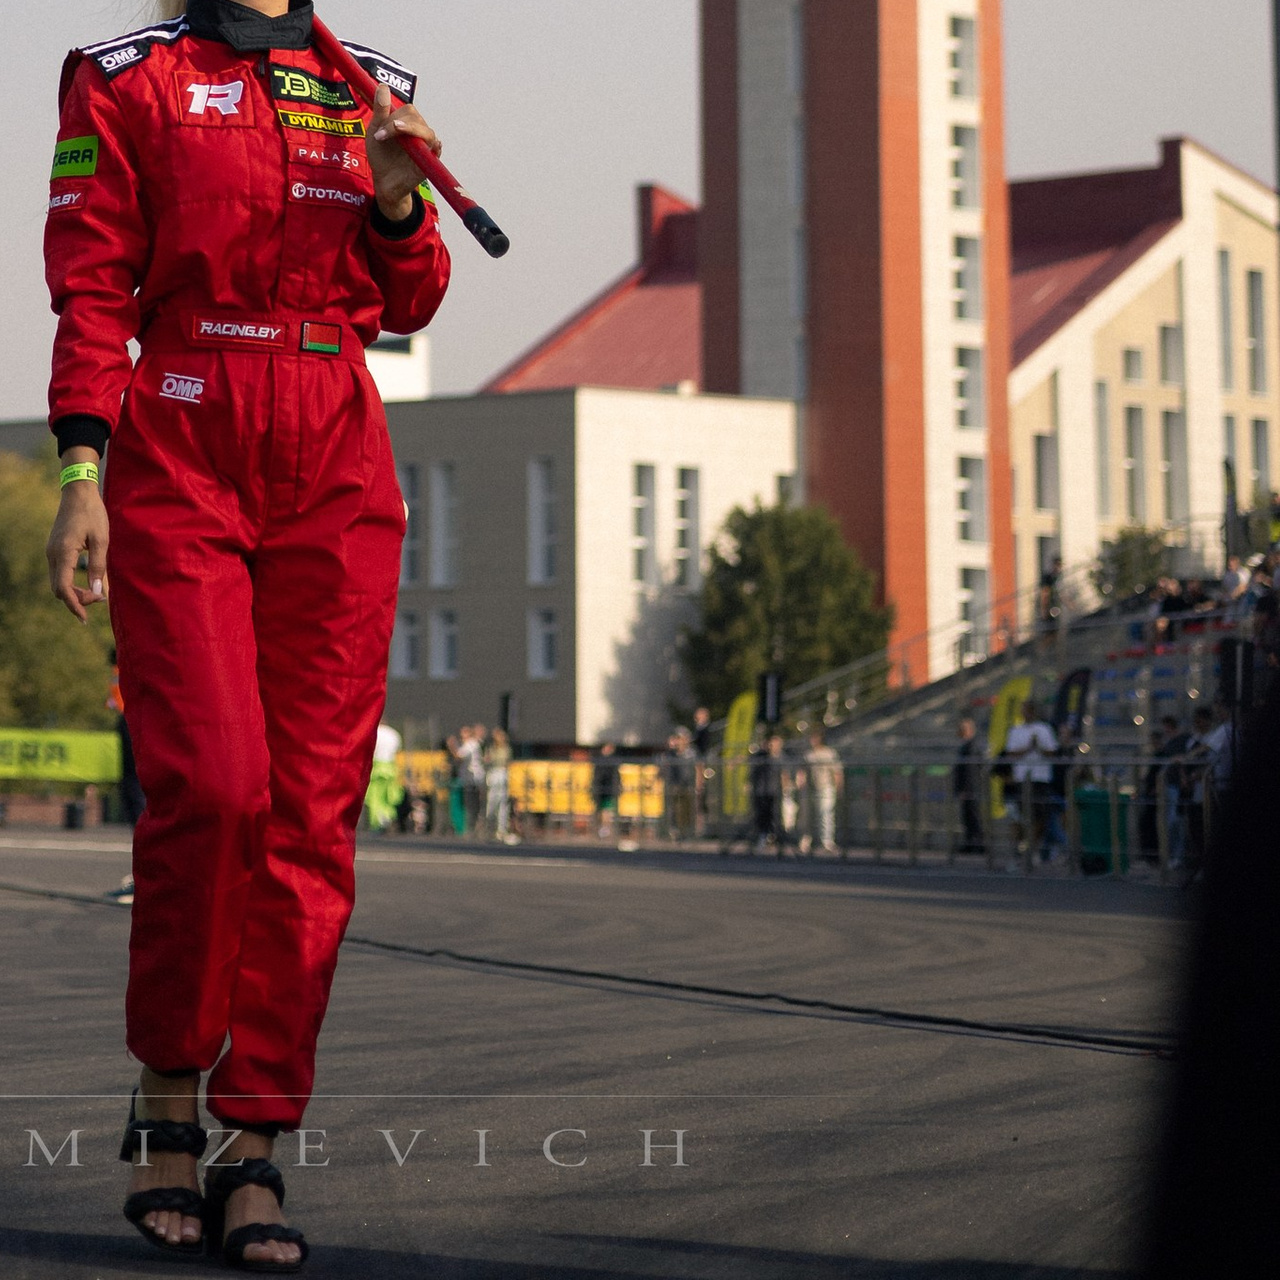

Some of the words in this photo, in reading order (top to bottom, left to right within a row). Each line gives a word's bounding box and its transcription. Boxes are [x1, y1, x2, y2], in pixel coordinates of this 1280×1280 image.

[101, 46, 139, 68] OMP
[376, 68, 412, 92] OMP
[199, 321, 281, 340] RACING.BY
[161, 377, 204, 399] OMP
